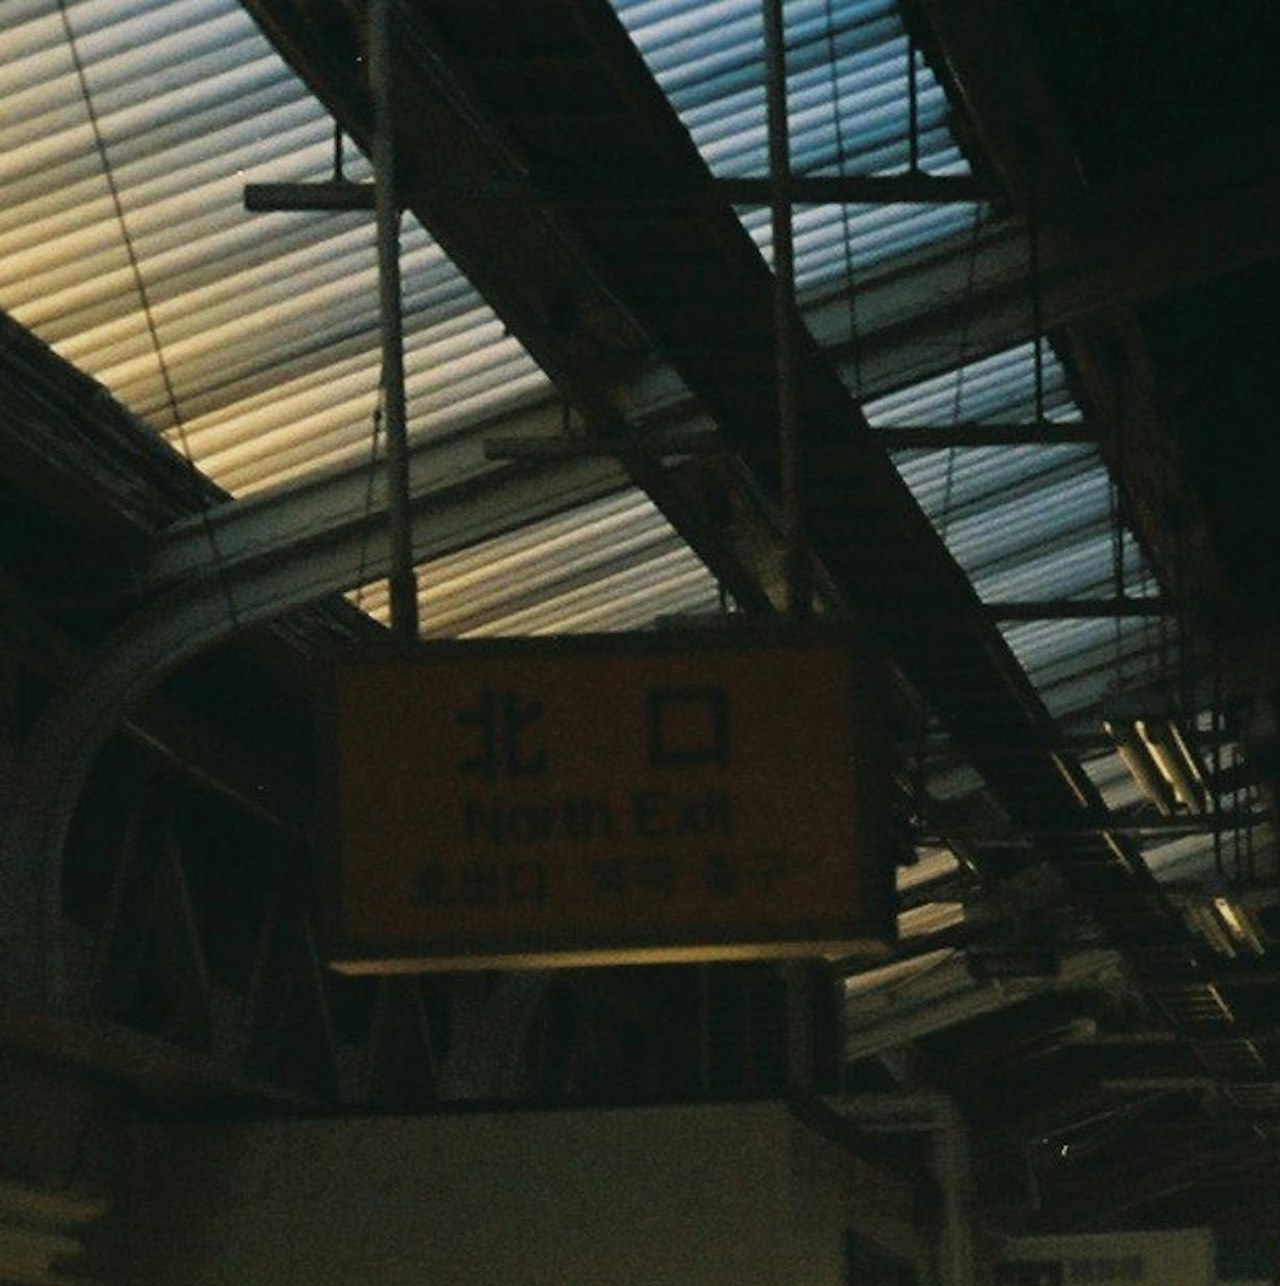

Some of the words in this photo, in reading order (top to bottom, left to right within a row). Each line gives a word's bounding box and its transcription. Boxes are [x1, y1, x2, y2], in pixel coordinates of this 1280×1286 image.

[452, 683, 729, 777] 北口
[462, 790, 611, 845] North
[634, 788, 733, 838] Exit
